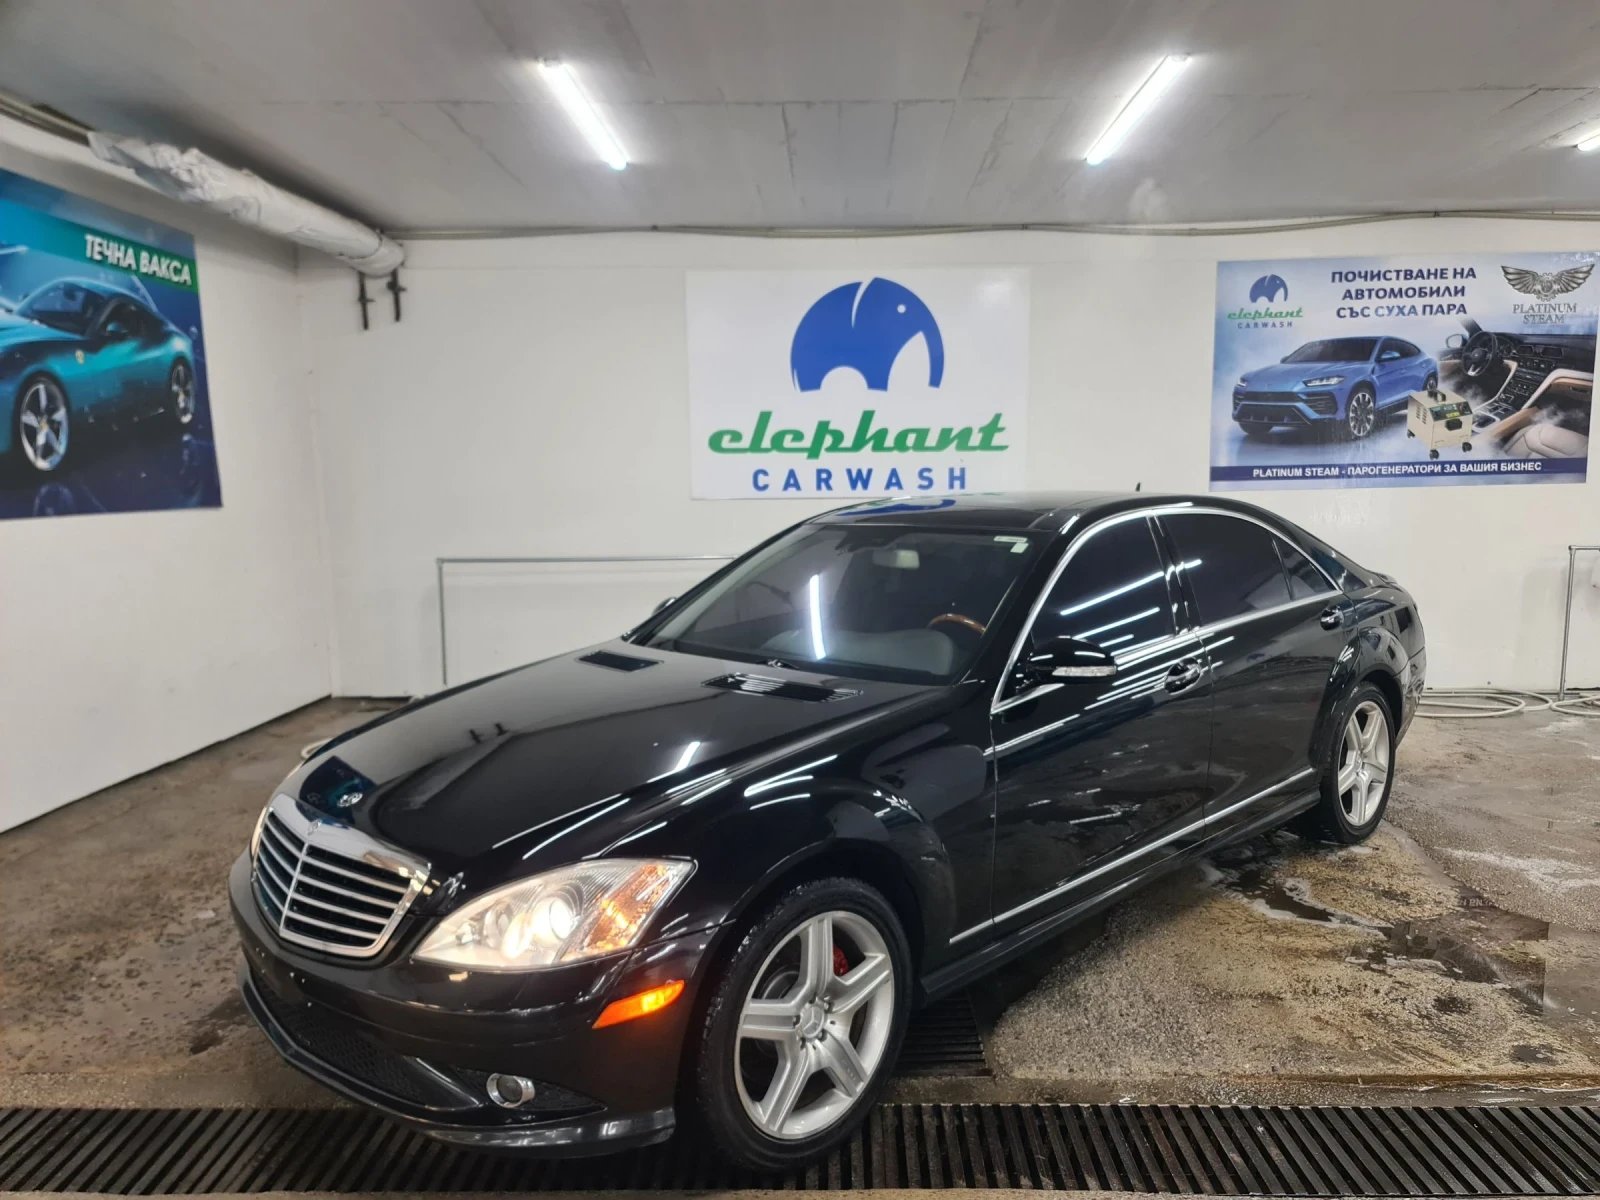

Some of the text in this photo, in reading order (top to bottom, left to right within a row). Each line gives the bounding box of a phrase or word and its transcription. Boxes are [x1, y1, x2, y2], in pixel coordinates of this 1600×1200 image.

[85, 234, 192, 285] ТЕЧНА ВАКСА
[1330, 267, 1477, 283] ПОЧИСТВАНЕ НА
[1341, 285, 1466, 301] АВТОМОБИЛИ
[1227, 307, 1303, 320] elephant
[1336, 303, 1468, 319] СЪС СУХА ПАРА
[1512, 303, 1577, 314] PLATINUM
[1237, 320, 1293, 329] CARWASH
[1522, 314, 1565, 325] STEAM
[708, 410, 1009, 460] elephant
[1253, 467, 1303, 478] PLATINUM
[1305, 467, 1339, 477] STEAM
[1347, 463, 1441, 476] ПАРОГЕНЕРАТОРИ
[1444, 463, 1458, 473] ЗА
[1460, 462, 1499, 473] ВАШИЯ
[1500, 461, 1542, 472] БИЗНЕС
[752, 467, 967, 492] CARWASH
